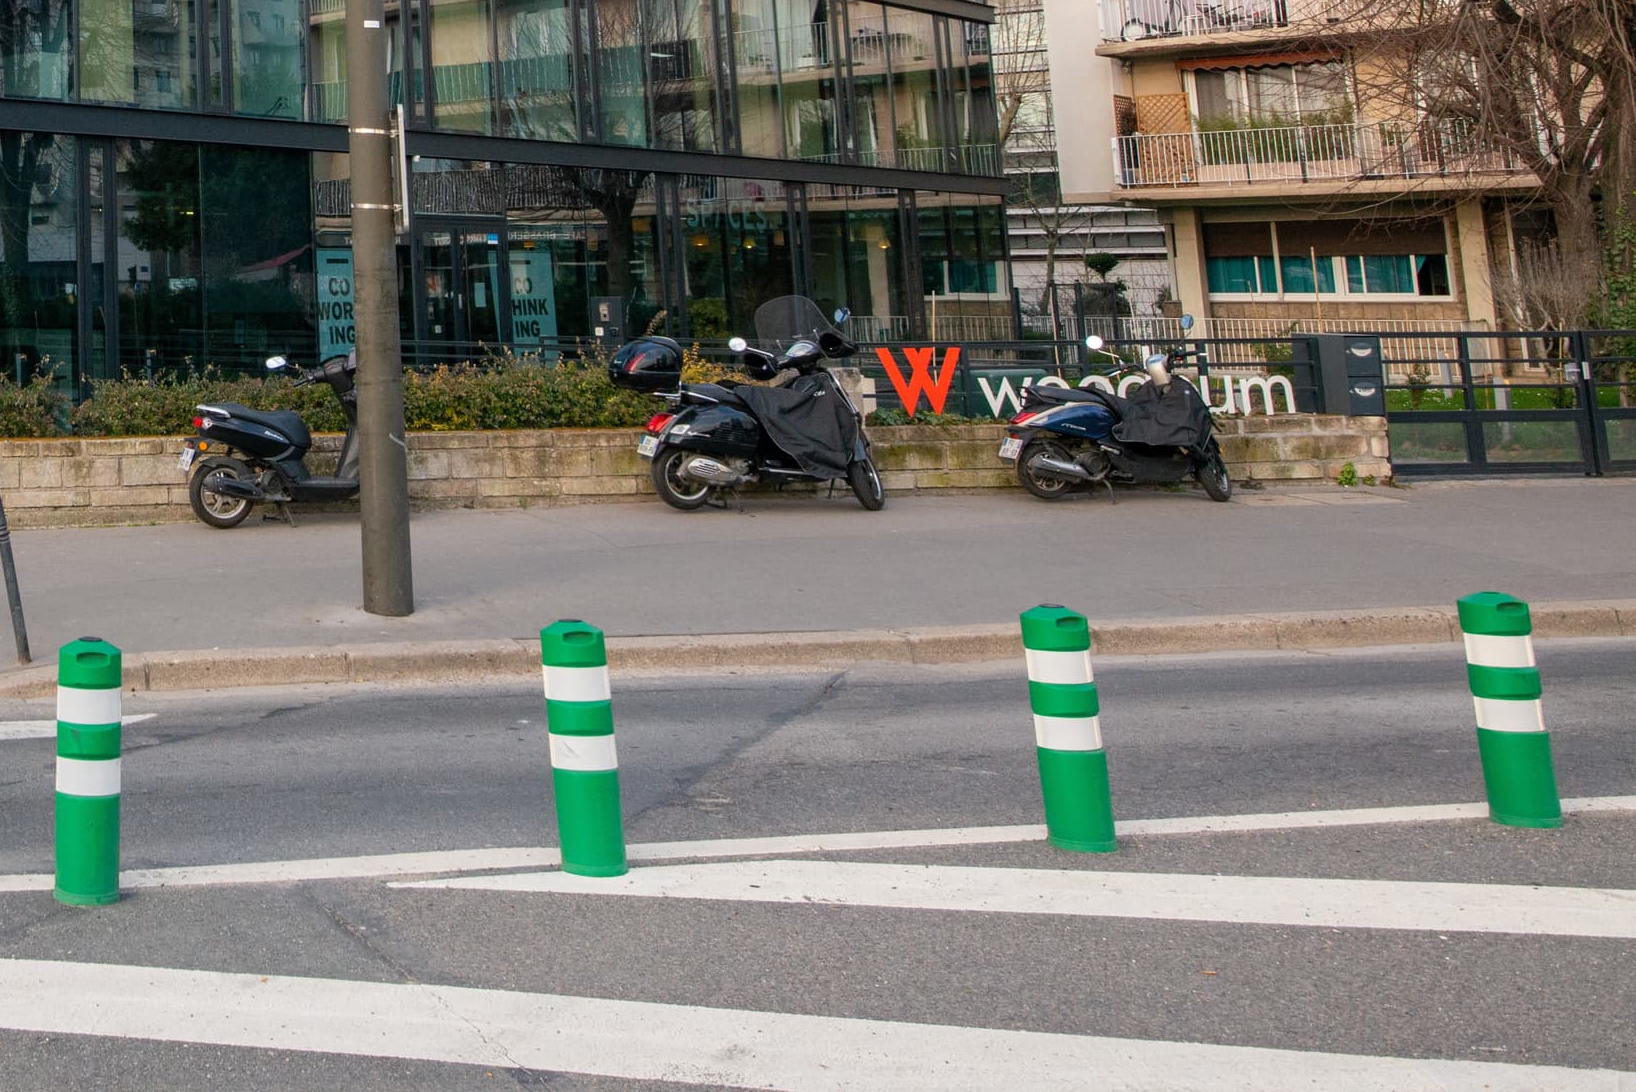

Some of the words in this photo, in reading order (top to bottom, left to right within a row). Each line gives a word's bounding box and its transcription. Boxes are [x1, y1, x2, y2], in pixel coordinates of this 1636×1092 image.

[329, 277, 351, 297] CO
[317, 301, 354, 321] WOR
[512, 298, 550, 317] HINK
[329, 325, 356, 345] ING
[515, 320, 541, 338] ING
